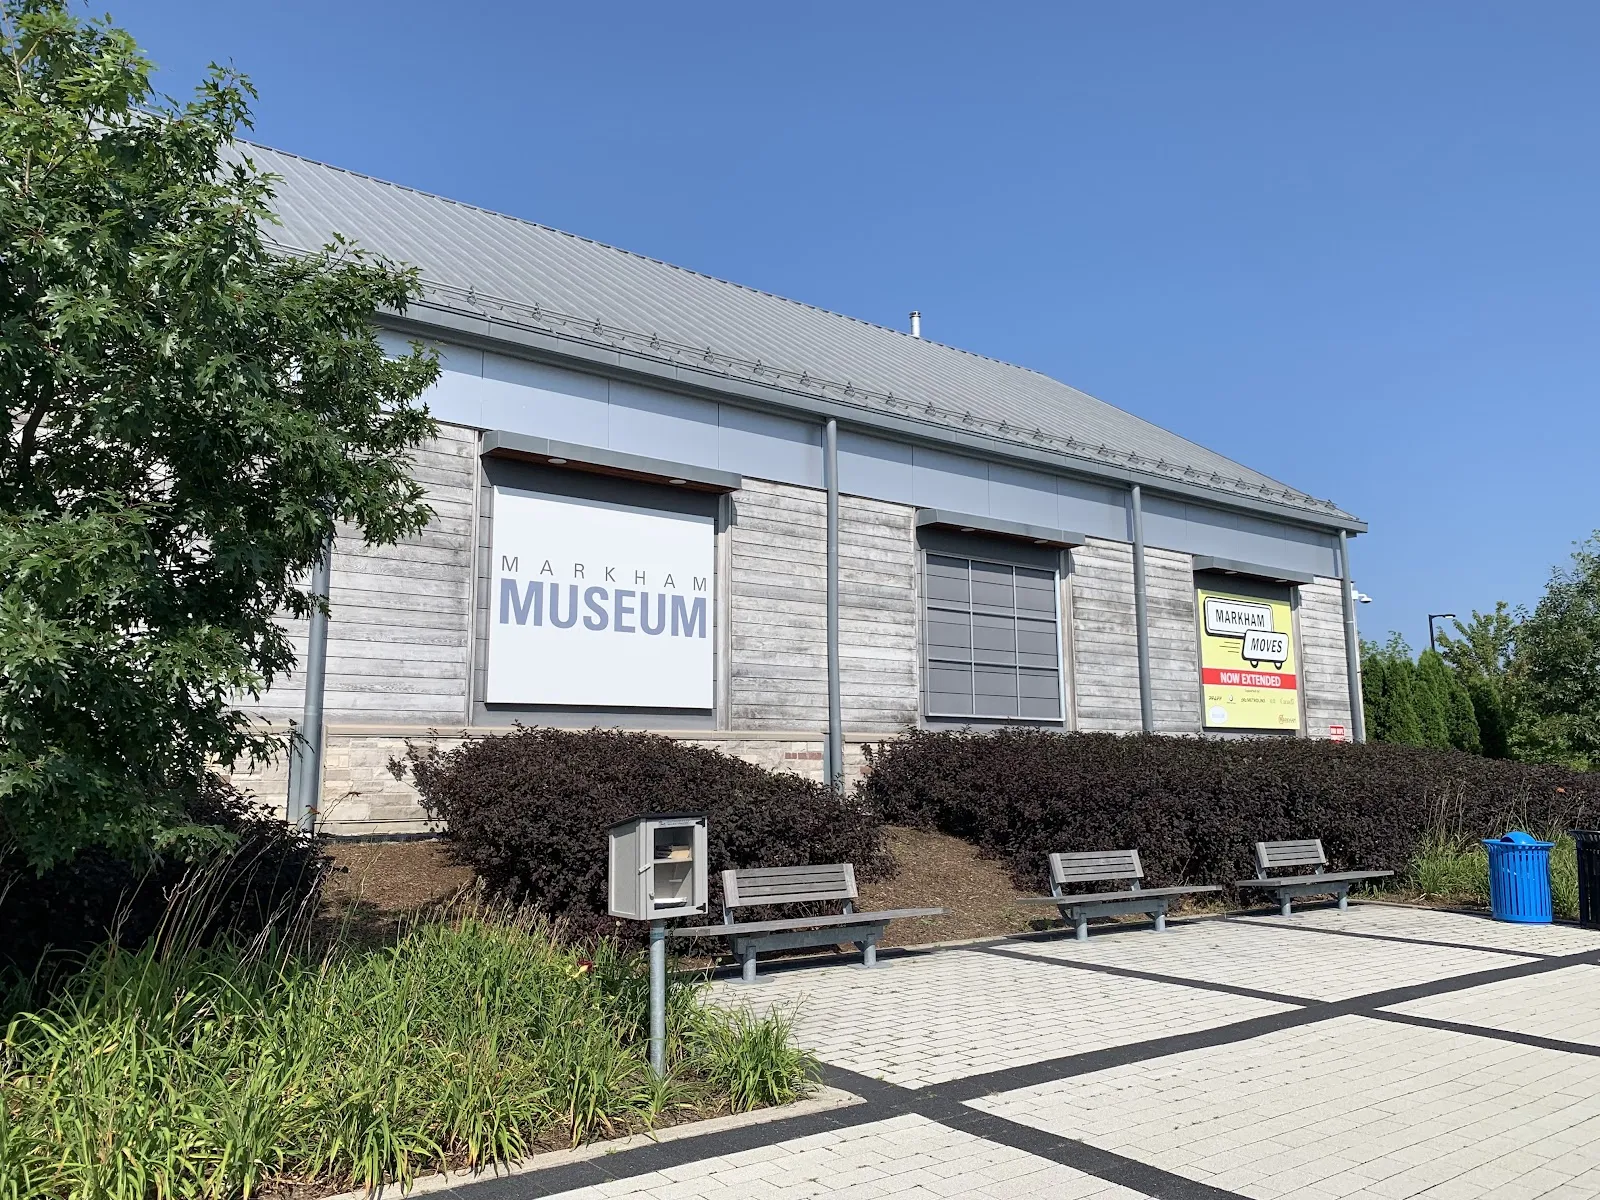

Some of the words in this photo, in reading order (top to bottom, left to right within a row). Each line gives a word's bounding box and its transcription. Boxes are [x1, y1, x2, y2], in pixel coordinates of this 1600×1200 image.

[501, 555, 707, 592] MARKHAM
[499, 577, 707, 639] MUSEUM
[1215, 609, 1265, 628] MARKHAM
[1250, 637, 1283, 653] MOVES
[1220, 672, 1240, 684] NOW
[1241, 673, 1281, 687] EXTENDED
